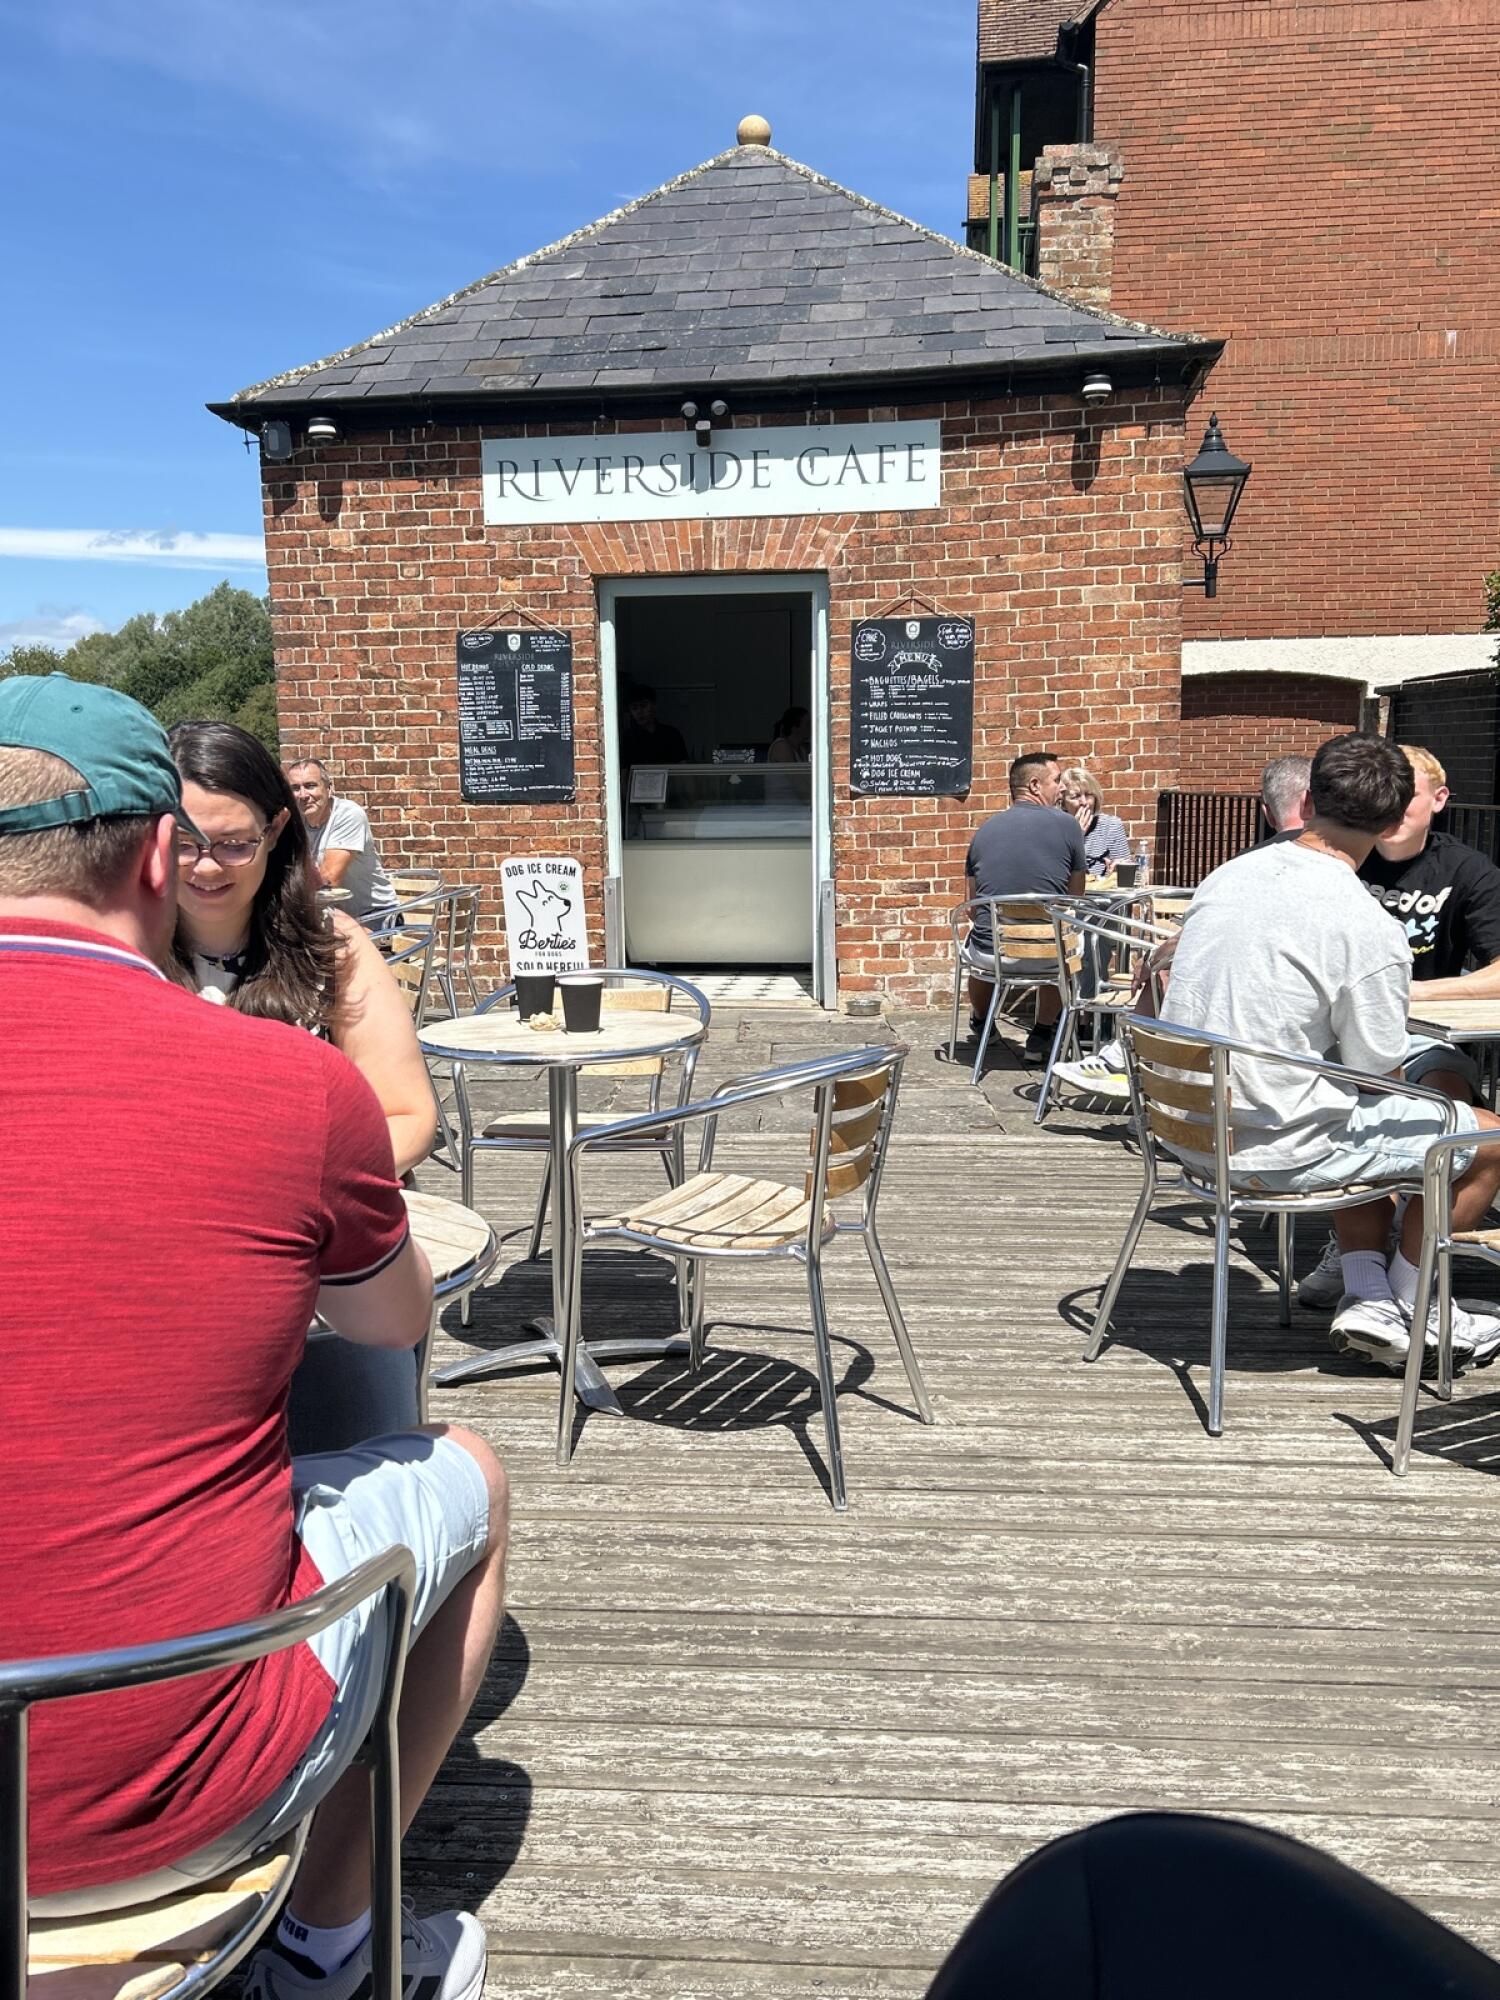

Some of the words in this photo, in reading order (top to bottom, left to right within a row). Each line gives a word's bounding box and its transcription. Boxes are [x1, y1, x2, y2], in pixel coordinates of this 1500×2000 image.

[496, 449, 772, 502] RIVERSIDE
[796, 441, 927, 488] CAFE
[891, 640, 935, 649] RIVERSIDE
[494, 653, 535, 661] RIVERSIDE
[900, 652, 929, 662] MENU
[869, 700, 888, 708] WRAPS
[869, 711, 888, 720] FILLED
[870, 739, 898, 748] NACHOS
[870, 754, 884, 762] HOT
[886, 754, 902, 762] DOGS
[870, 769, 886, 777] DOG
[888, 769, 898, 778] ICE
[900, 769, 921, 778] CREAM
[505, 864, 525, 878] DOG
[527, 863, 542, 875] ICE
[545, 863, 576, 878] CREAM
[518, 929, 576, 950] Bertie's
